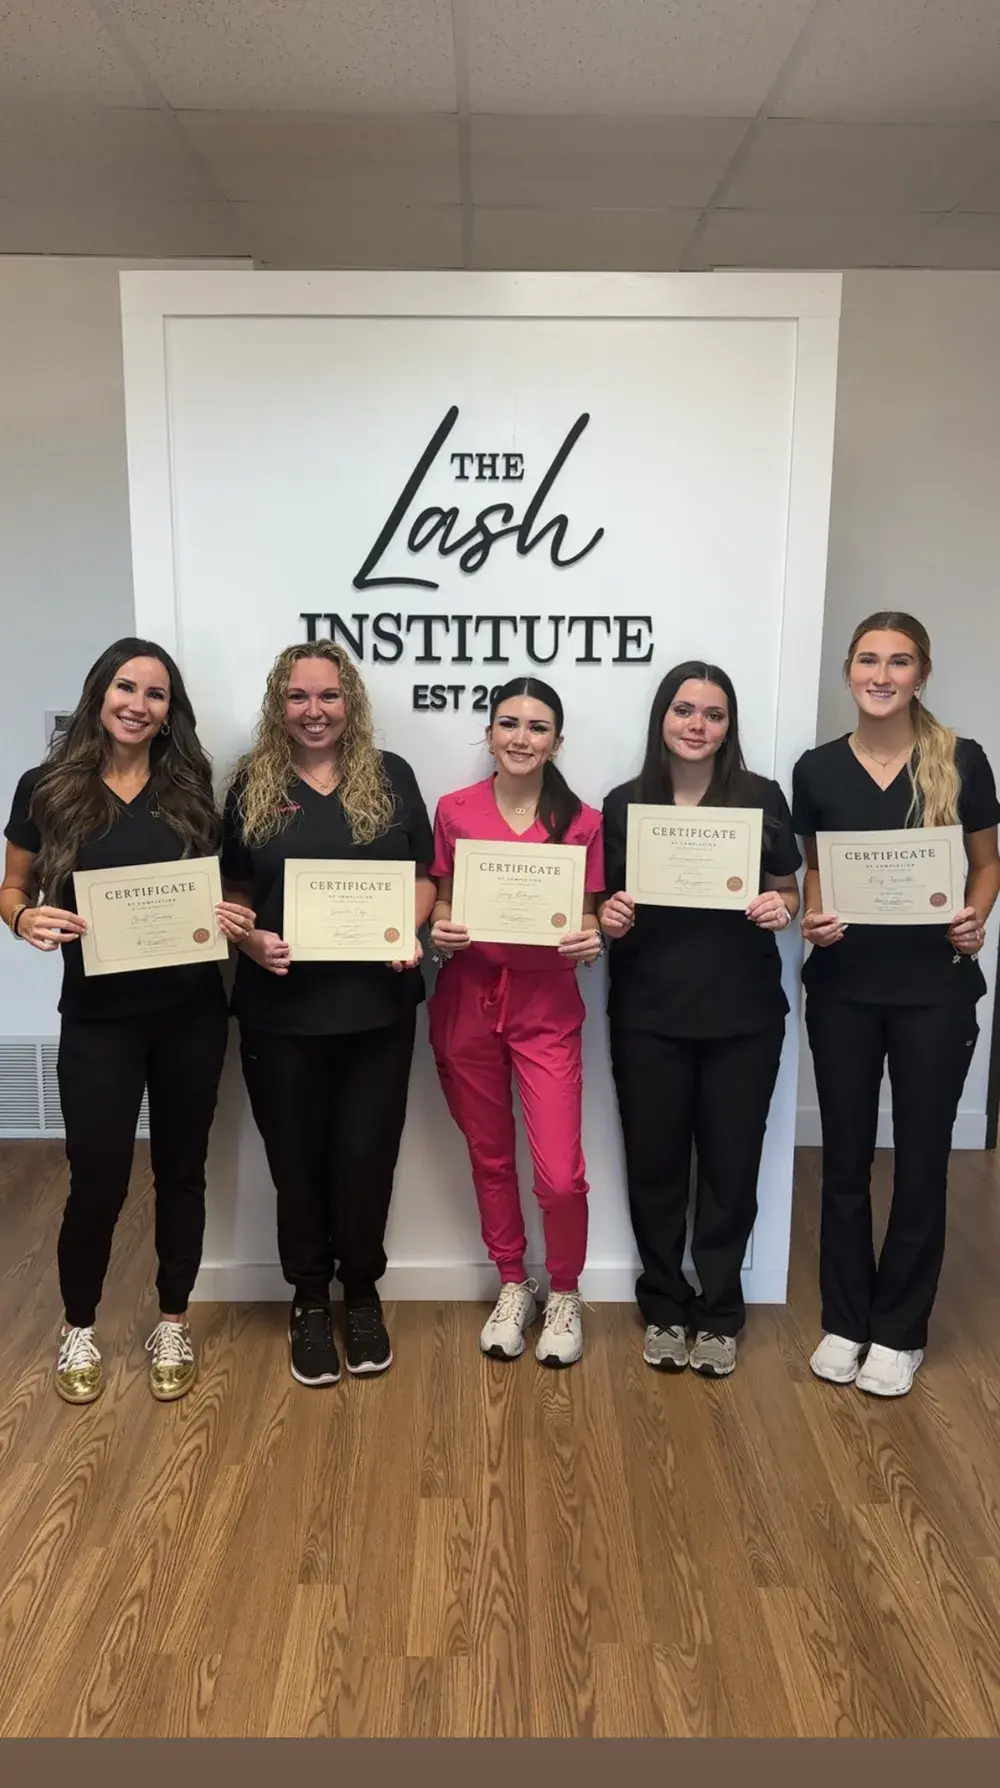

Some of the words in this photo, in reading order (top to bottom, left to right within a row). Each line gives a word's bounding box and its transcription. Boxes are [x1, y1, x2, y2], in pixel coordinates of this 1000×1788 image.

[450, 452, 525, 480] THE
[352, 405, 605, 591] Lash
[300, 612, 655, 663] INSTITUTE
[413, 685, 466, 710] EST
[652, 826, 737, 839] CERTIFICATE
[844, 848, 936, 861] CERTIFICATE
[479, 862, 561, 875] CERTIFICATE
[105, 881, 197, 901] CERTIFICATE
[309, 881, 392, 891] CERTIFICATE
